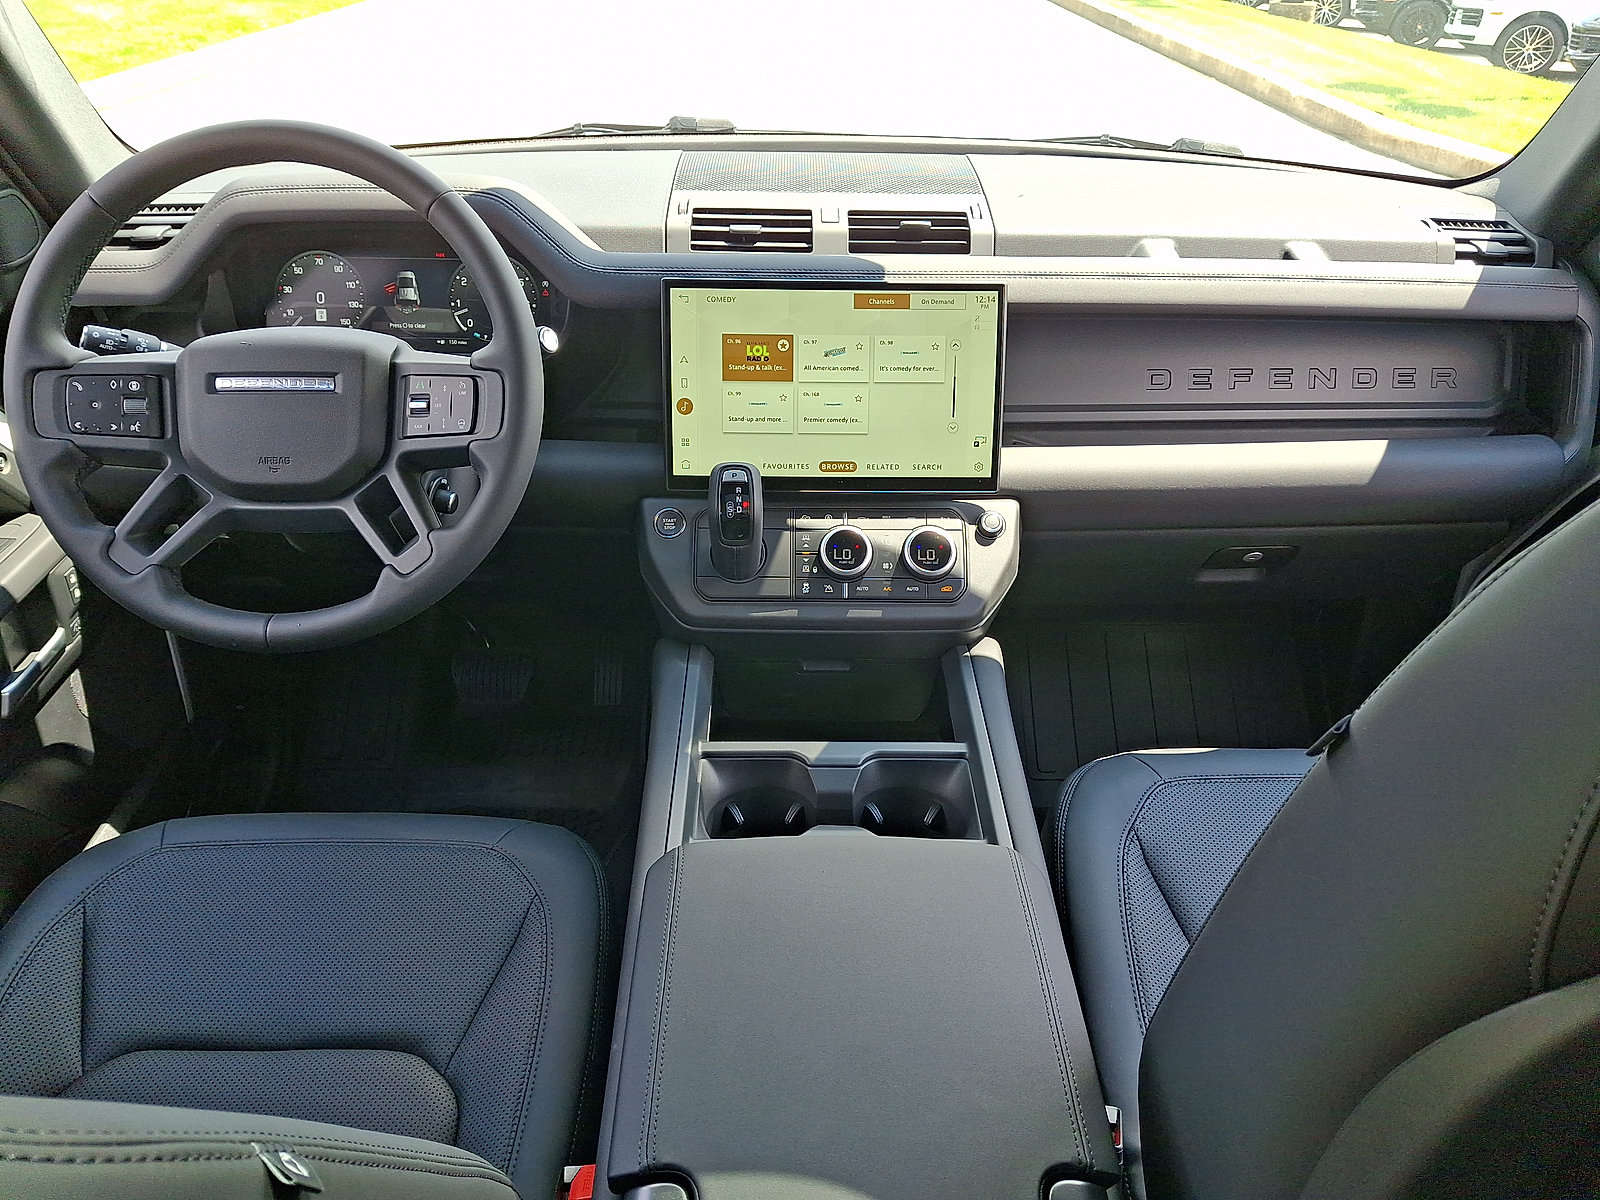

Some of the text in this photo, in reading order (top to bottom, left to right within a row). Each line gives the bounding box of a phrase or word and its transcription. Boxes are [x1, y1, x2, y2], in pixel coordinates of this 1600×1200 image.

[460, 277, 467, 286] 2
[316, 292, 325, 304] 0
[456, 299, 460, 307] 1
[466, 318, 474, 327] 0
[746, 345, 770, 356] LOL
[728, 364, 754, 372] Stand-up
[1146, 368, 1458, 391] DEFENDER
[258, 457, 291, 465] AIRBAG
[834, 549, 852, 560] LO
[918, 549, 936, 560] LO
